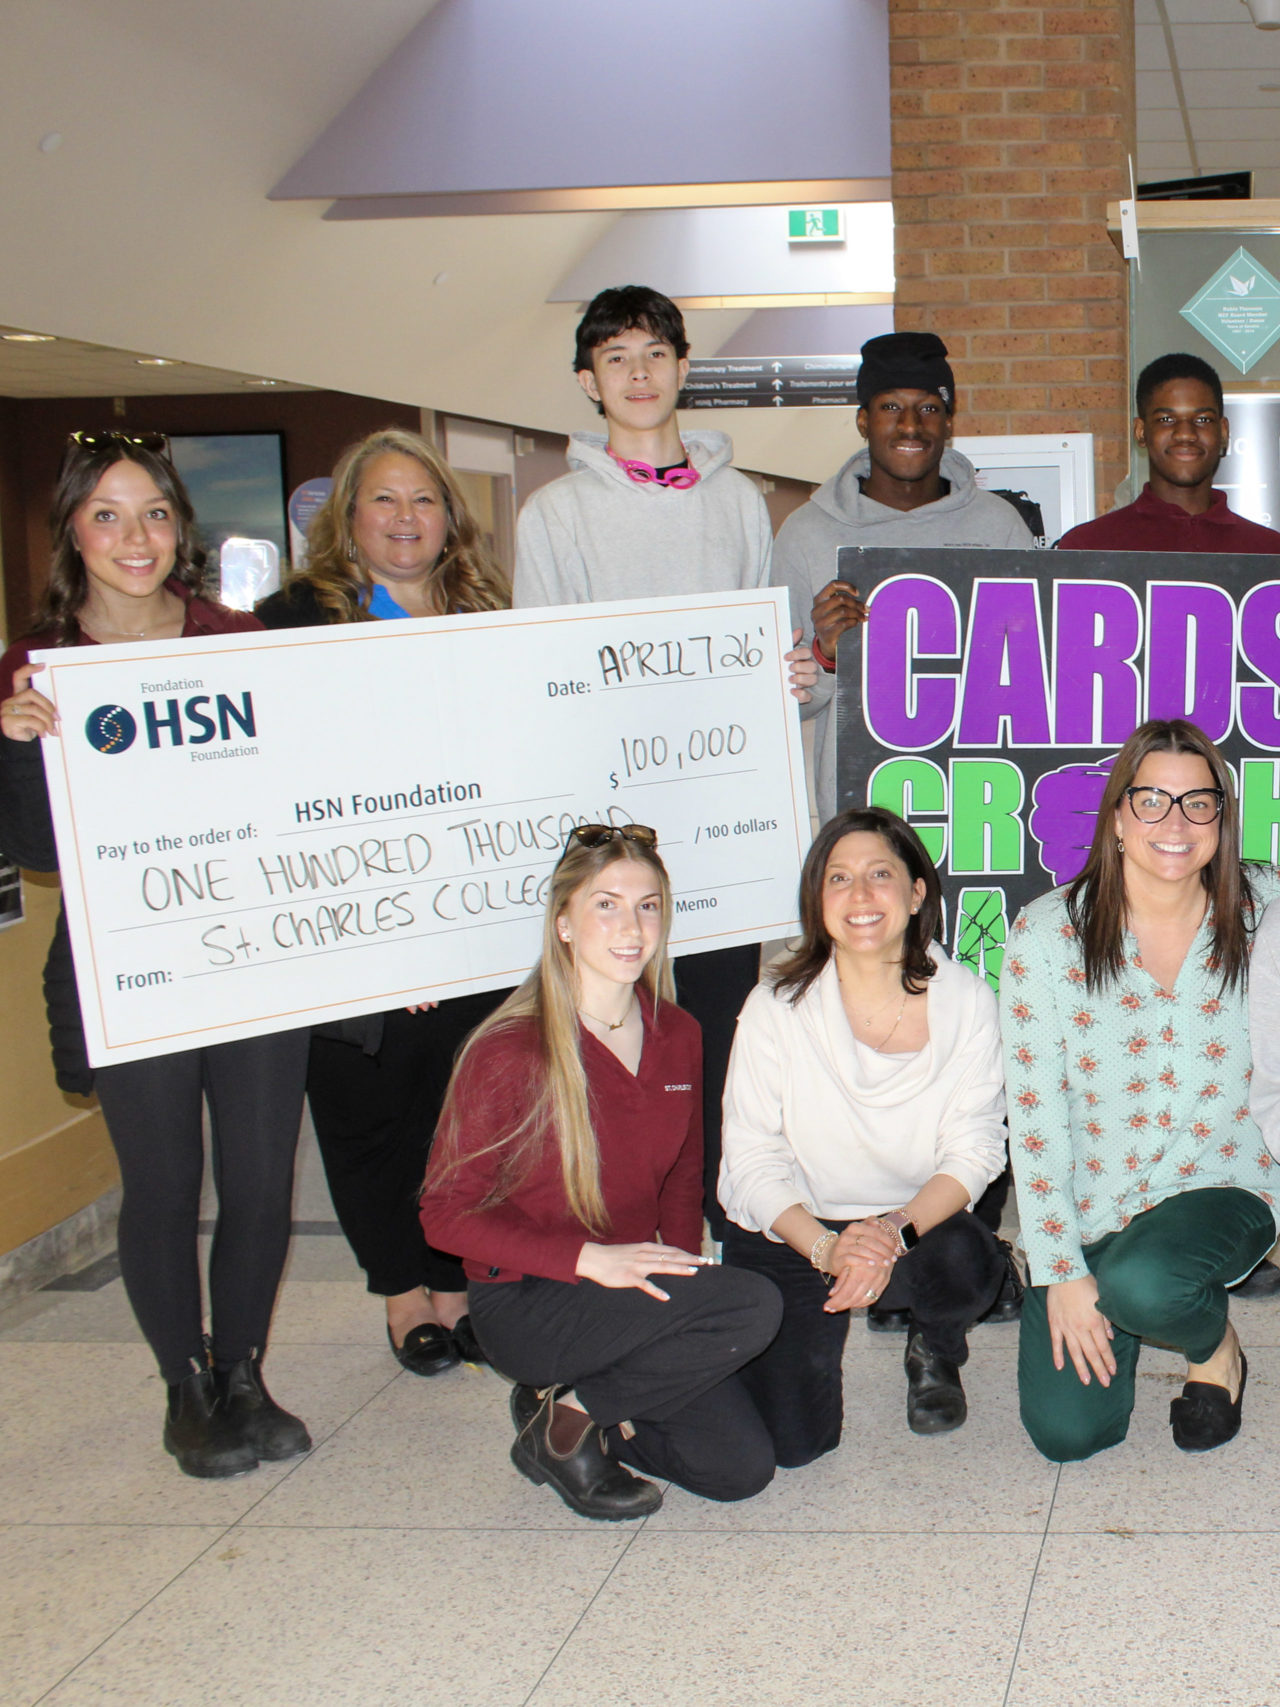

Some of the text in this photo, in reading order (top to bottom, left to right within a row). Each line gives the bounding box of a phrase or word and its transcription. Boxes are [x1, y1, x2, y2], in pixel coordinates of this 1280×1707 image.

[598, 641, 696, 686] APRIL
[688, 636, 713, 674] 7
[141, 678, 204, 693] Fondation
[547, 679, 592, 697] Date:
[143, 691, 257, 749] HSN
[190, 745, 260, 762] Foundation
[621, 724, 747, 777] 100,000
[610, 771, 619, 790] $
[96, 781, 482, 861] Pay to the order of: HSN Foundation
[705, 824, 729, 839] 100
[733, 818, 778, 835] dollars
[142, 859, 235, 911] ONE
[258, 832, 432, 895] HUNDRED
[432, 874, 552, 921] COLLEG
[675, 897, 718, 914] Memo
[116, 969, 173, 991] From:
